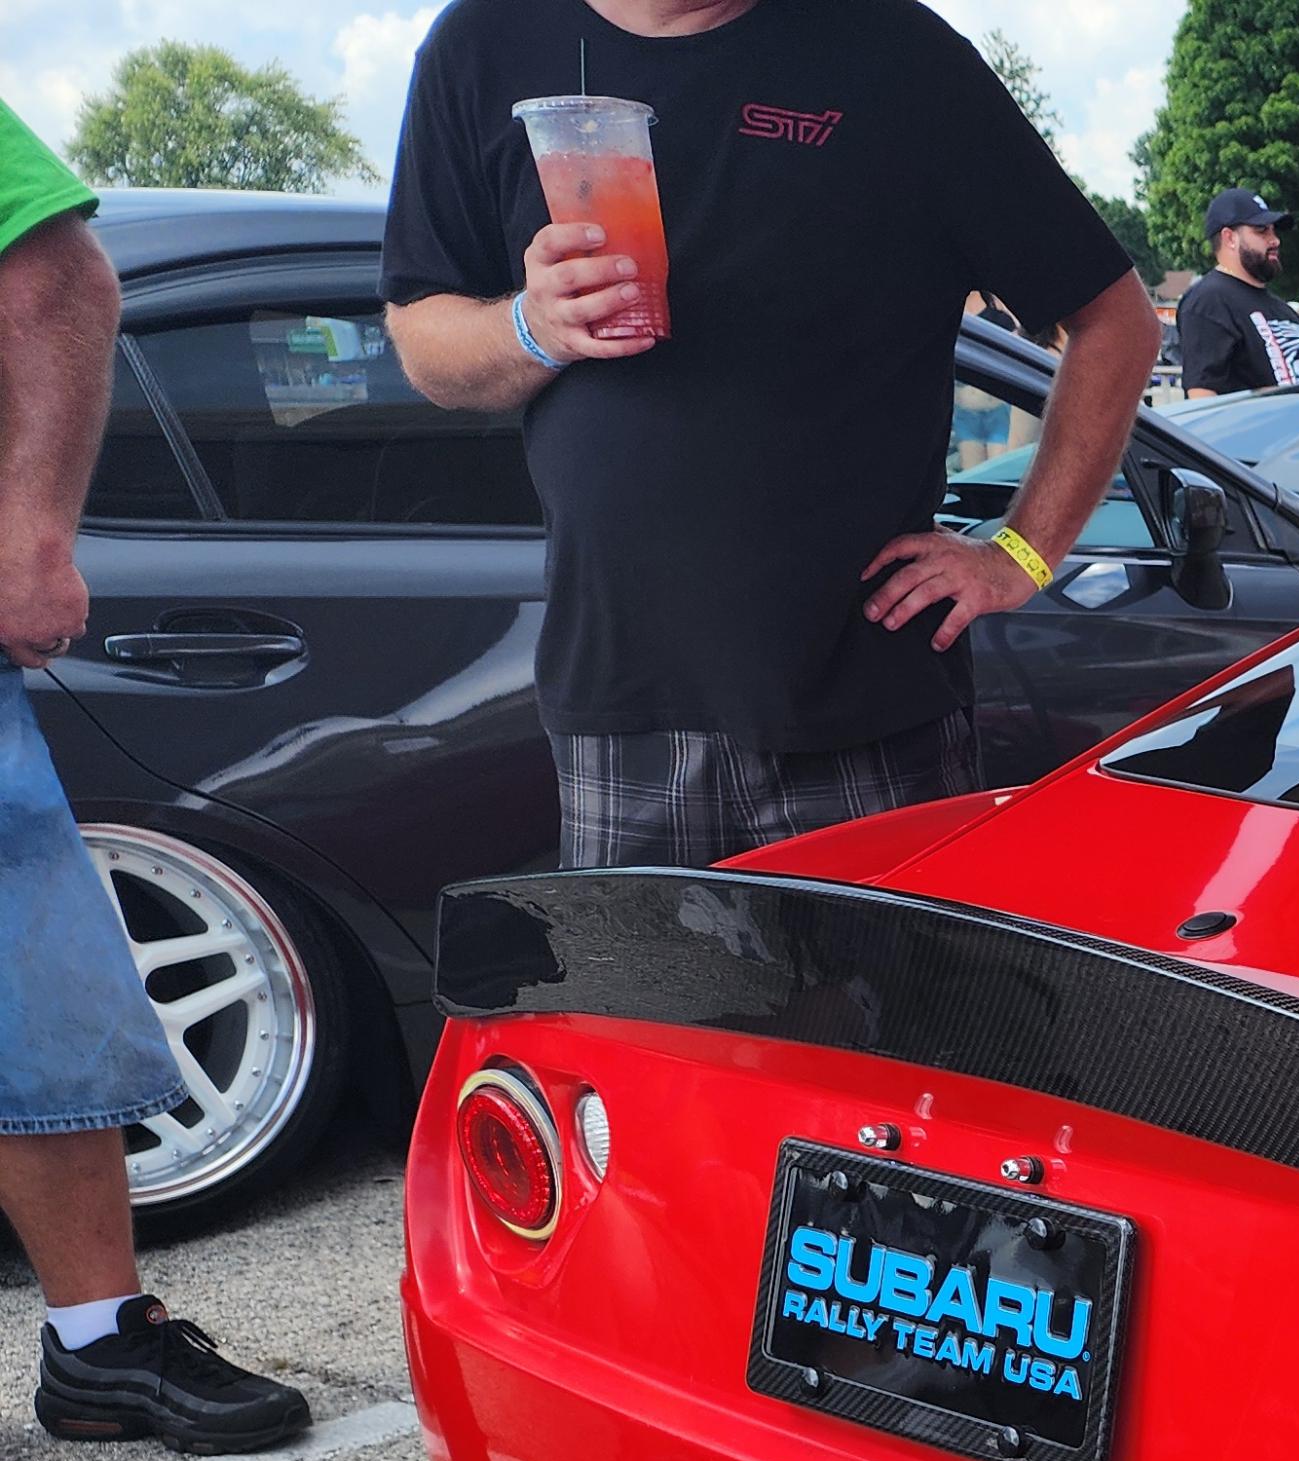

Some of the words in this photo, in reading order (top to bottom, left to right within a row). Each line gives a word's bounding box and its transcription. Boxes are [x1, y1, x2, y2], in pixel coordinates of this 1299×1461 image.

[783, 1288, 888, 1342] RALLY
[893, 1317, 996, 1376] TEAM
[1003, 1347, 1083, 1401] USA
[787, 1226, 1093, 1360] SUBARU
